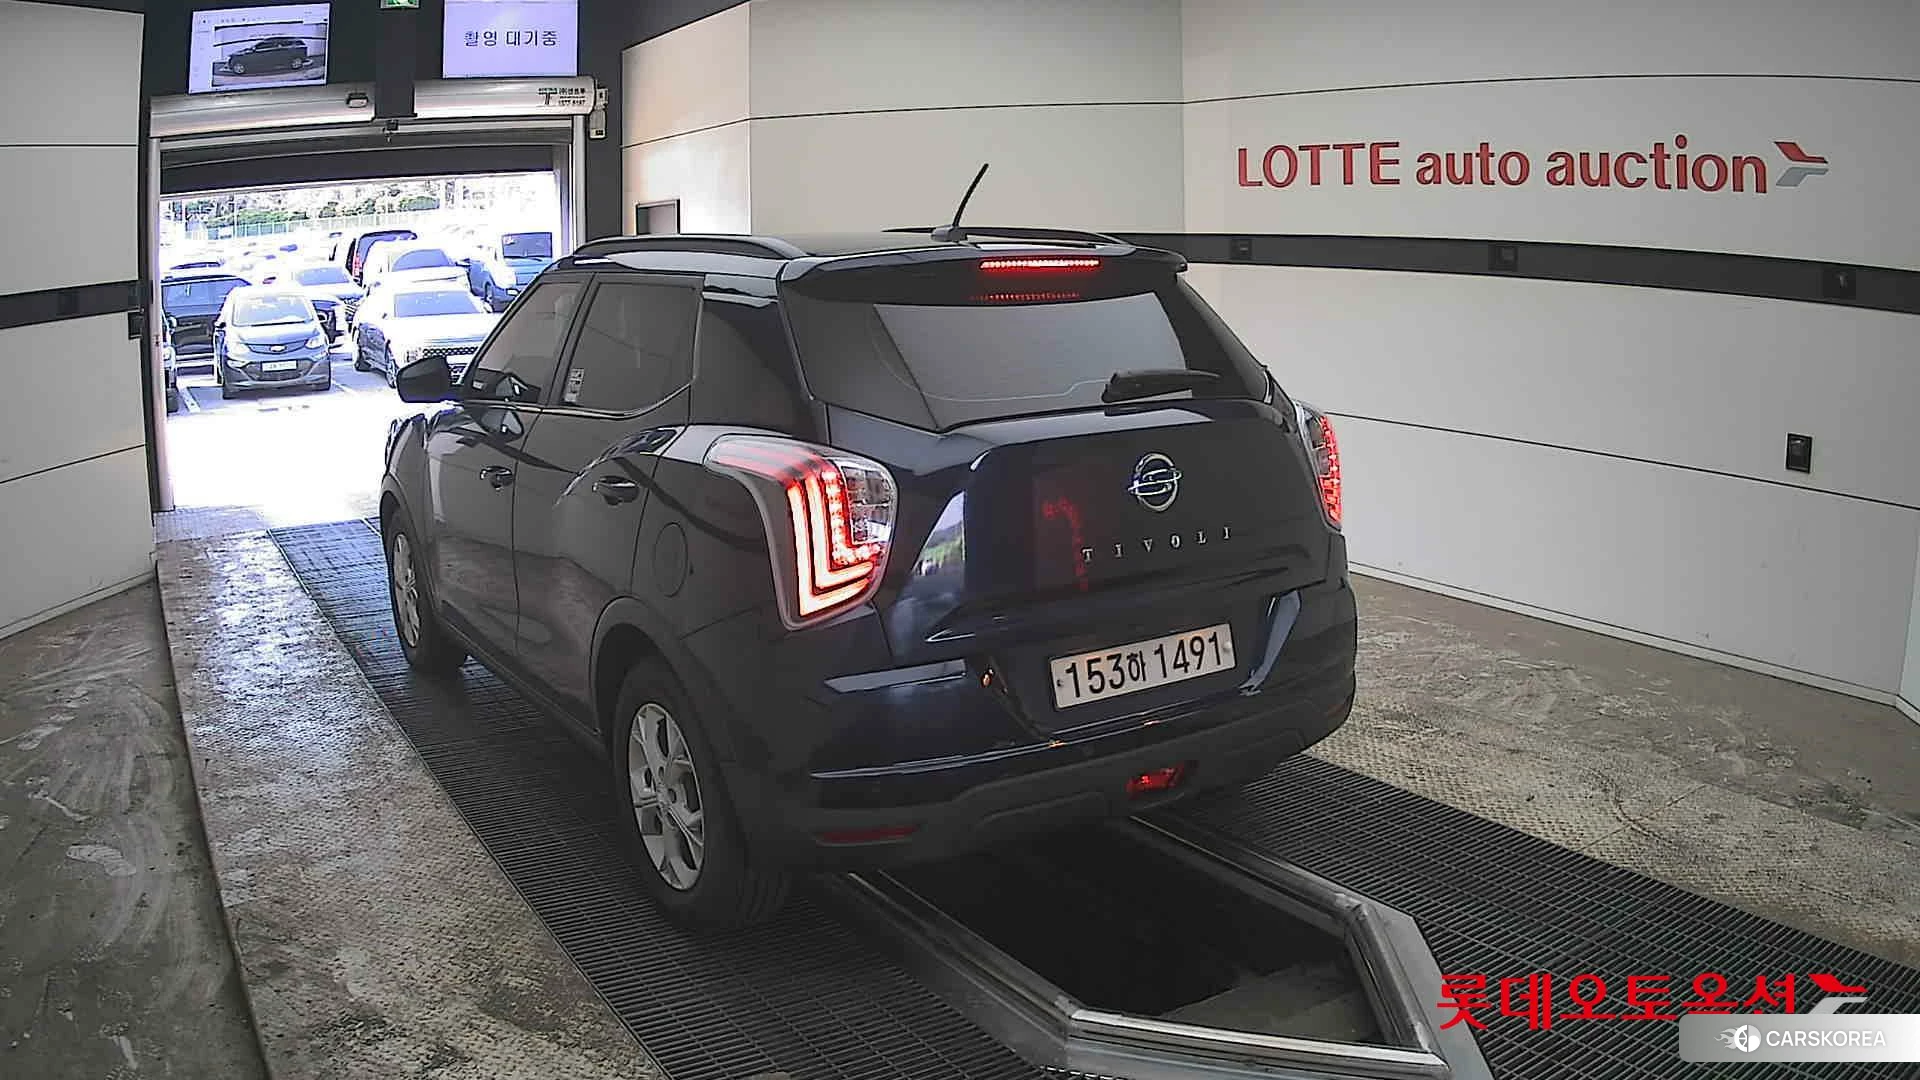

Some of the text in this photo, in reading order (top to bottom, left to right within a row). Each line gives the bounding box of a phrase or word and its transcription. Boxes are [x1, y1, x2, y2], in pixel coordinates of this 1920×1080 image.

[505, 30, 558, 47] 대기중
[1237, 134, 1768, 194] LOTTE auto auction
[1081, 526, 1231, 562] TIVOLI
[1064, 631, 1222, 698] 153하 1491
